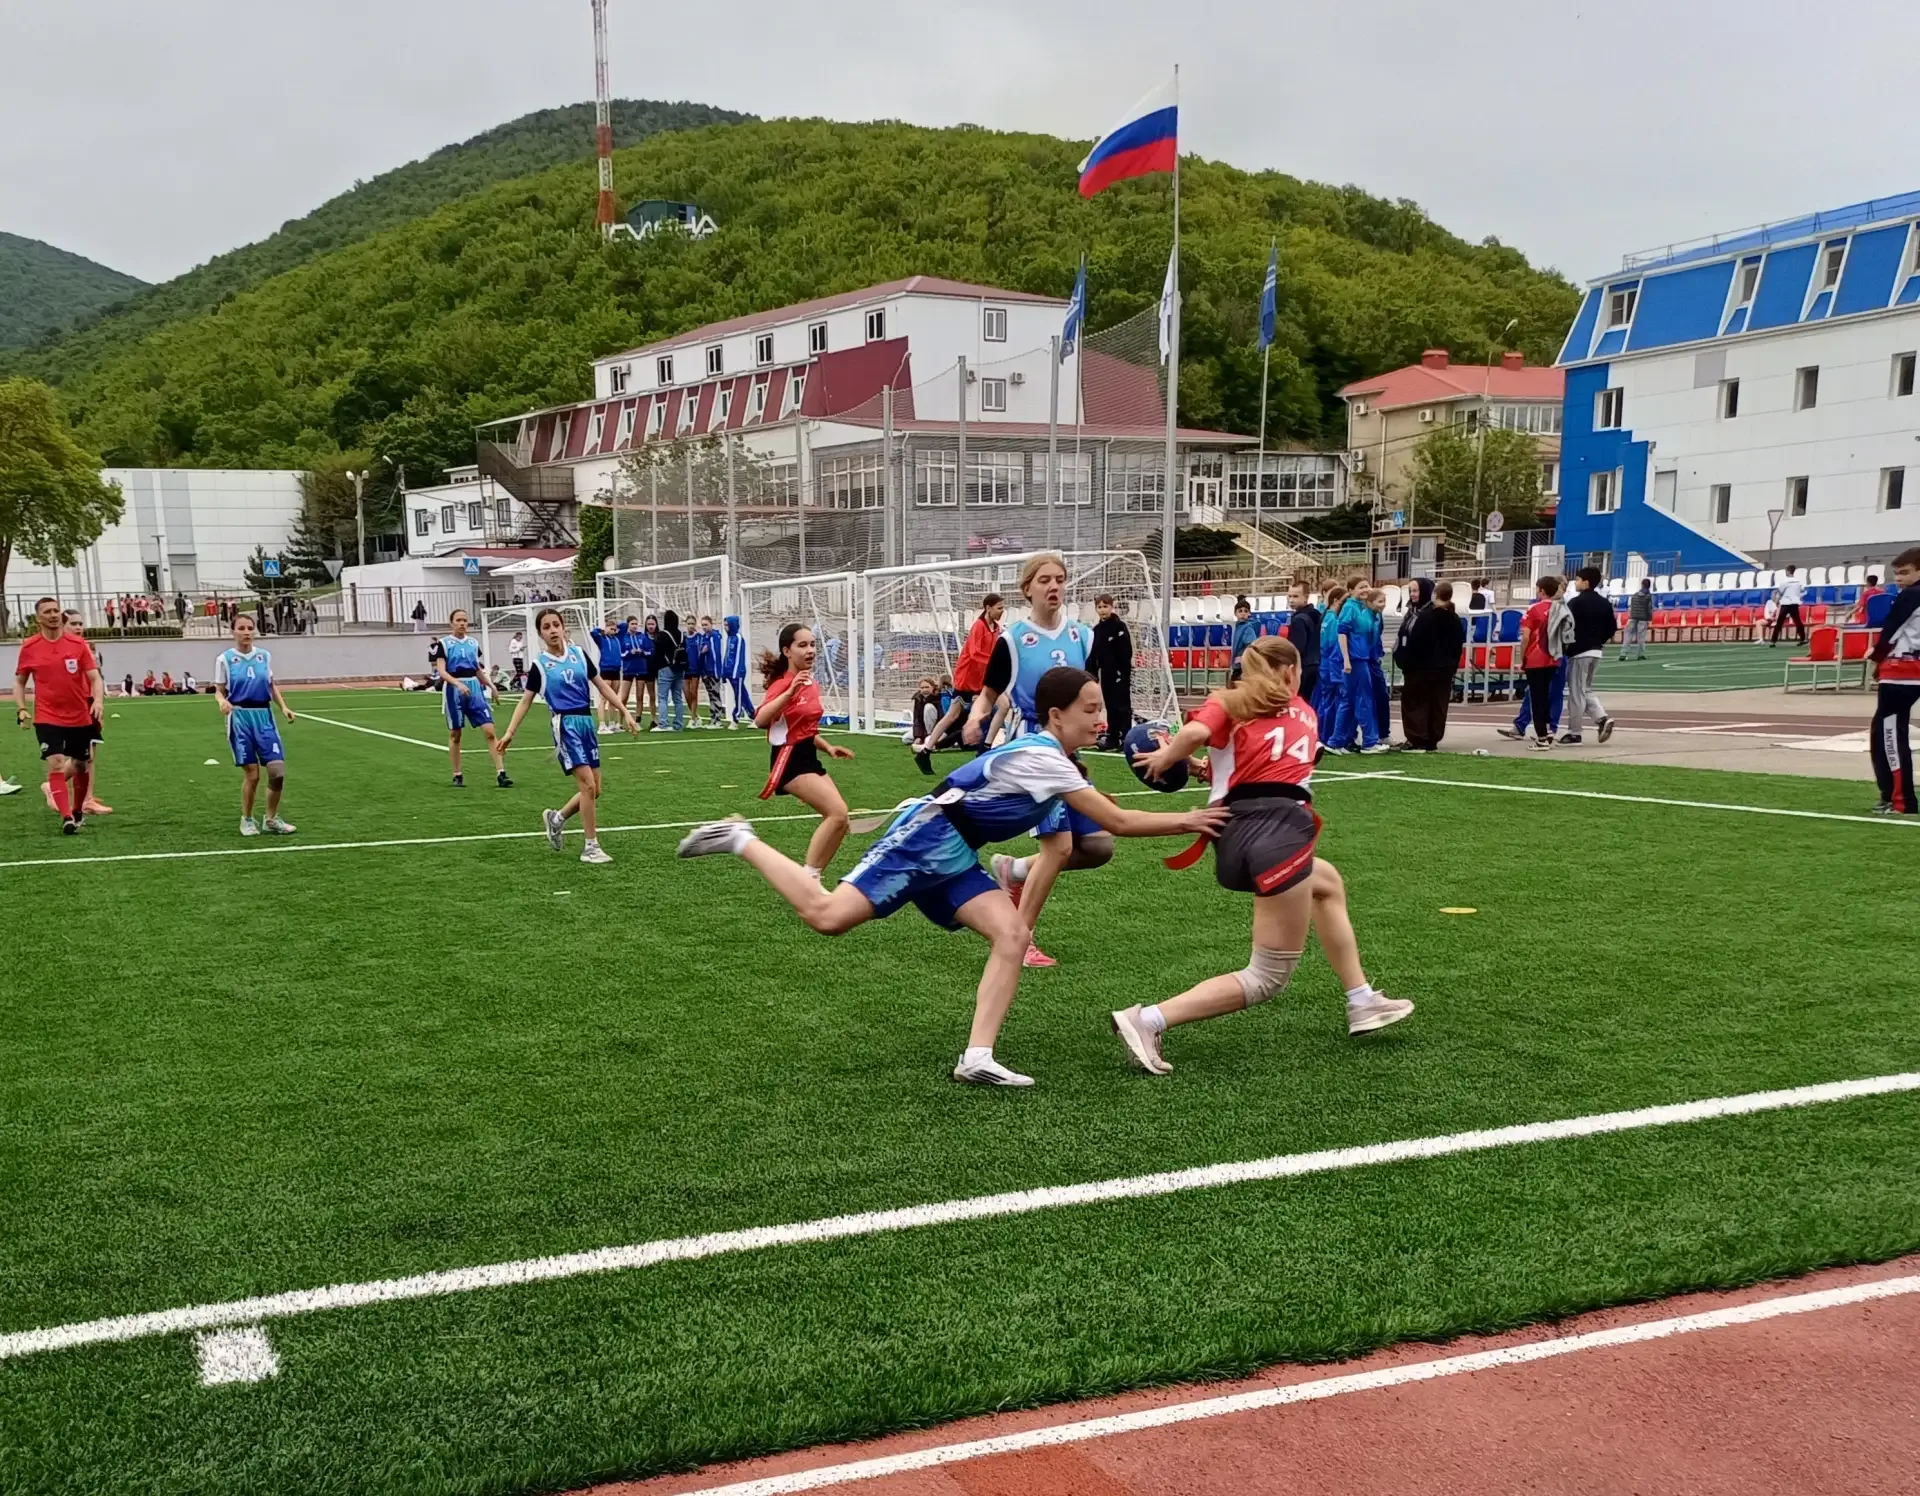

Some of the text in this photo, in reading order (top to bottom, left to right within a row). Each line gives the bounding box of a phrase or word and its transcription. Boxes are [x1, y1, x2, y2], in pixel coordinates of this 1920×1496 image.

[247, 666, 255, 679] 4
[561, 668, 576, 684] 12
[1264, 726, 1310, 764] 14
